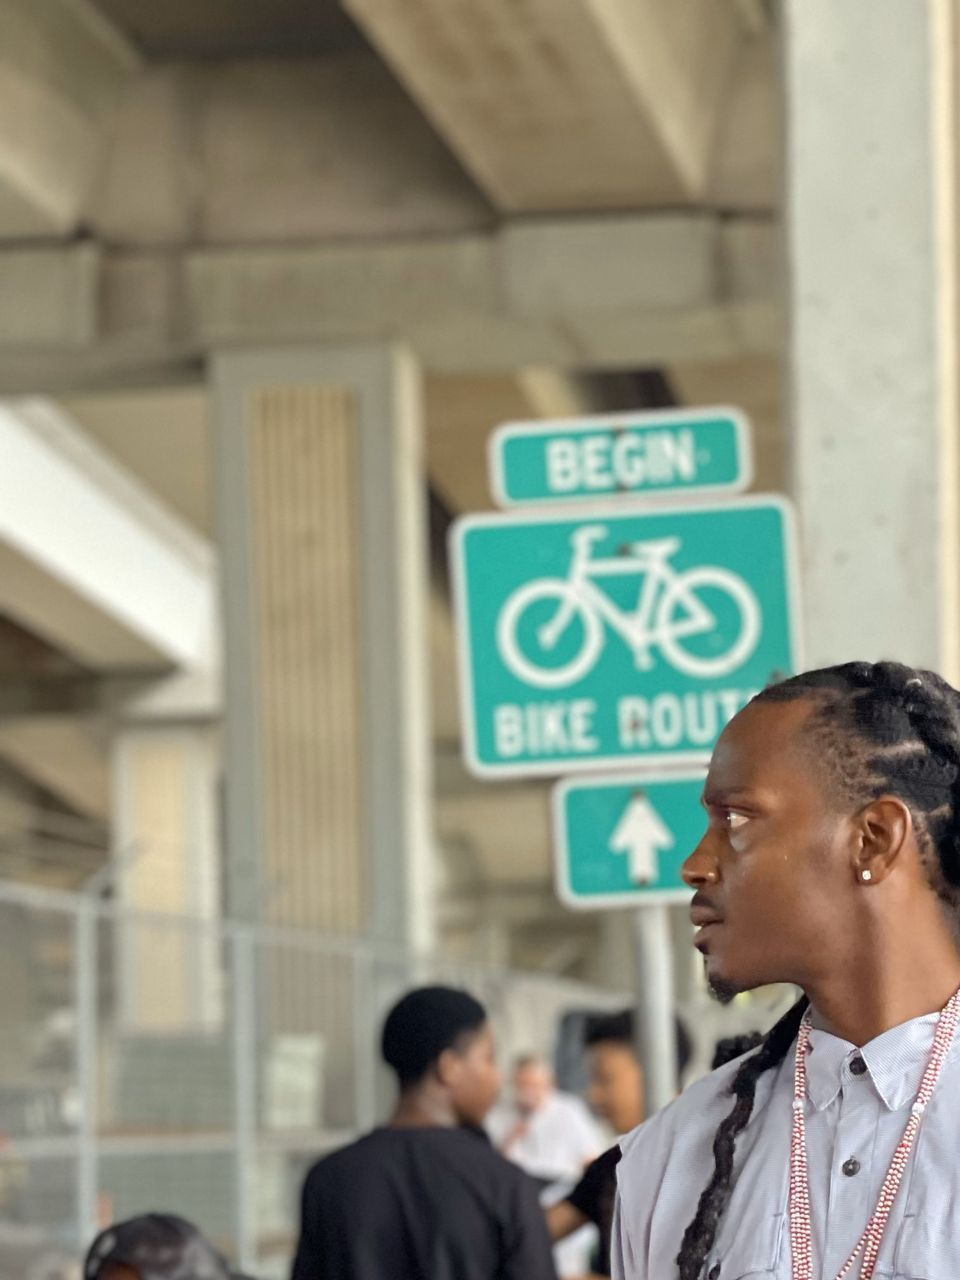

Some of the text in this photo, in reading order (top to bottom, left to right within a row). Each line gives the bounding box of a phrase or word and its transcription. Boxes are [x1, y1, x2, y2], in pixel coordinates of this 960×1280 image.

[546, 430, 696, 491] BEGIN
[493, 687, 756, 757] BIKE ROUT
